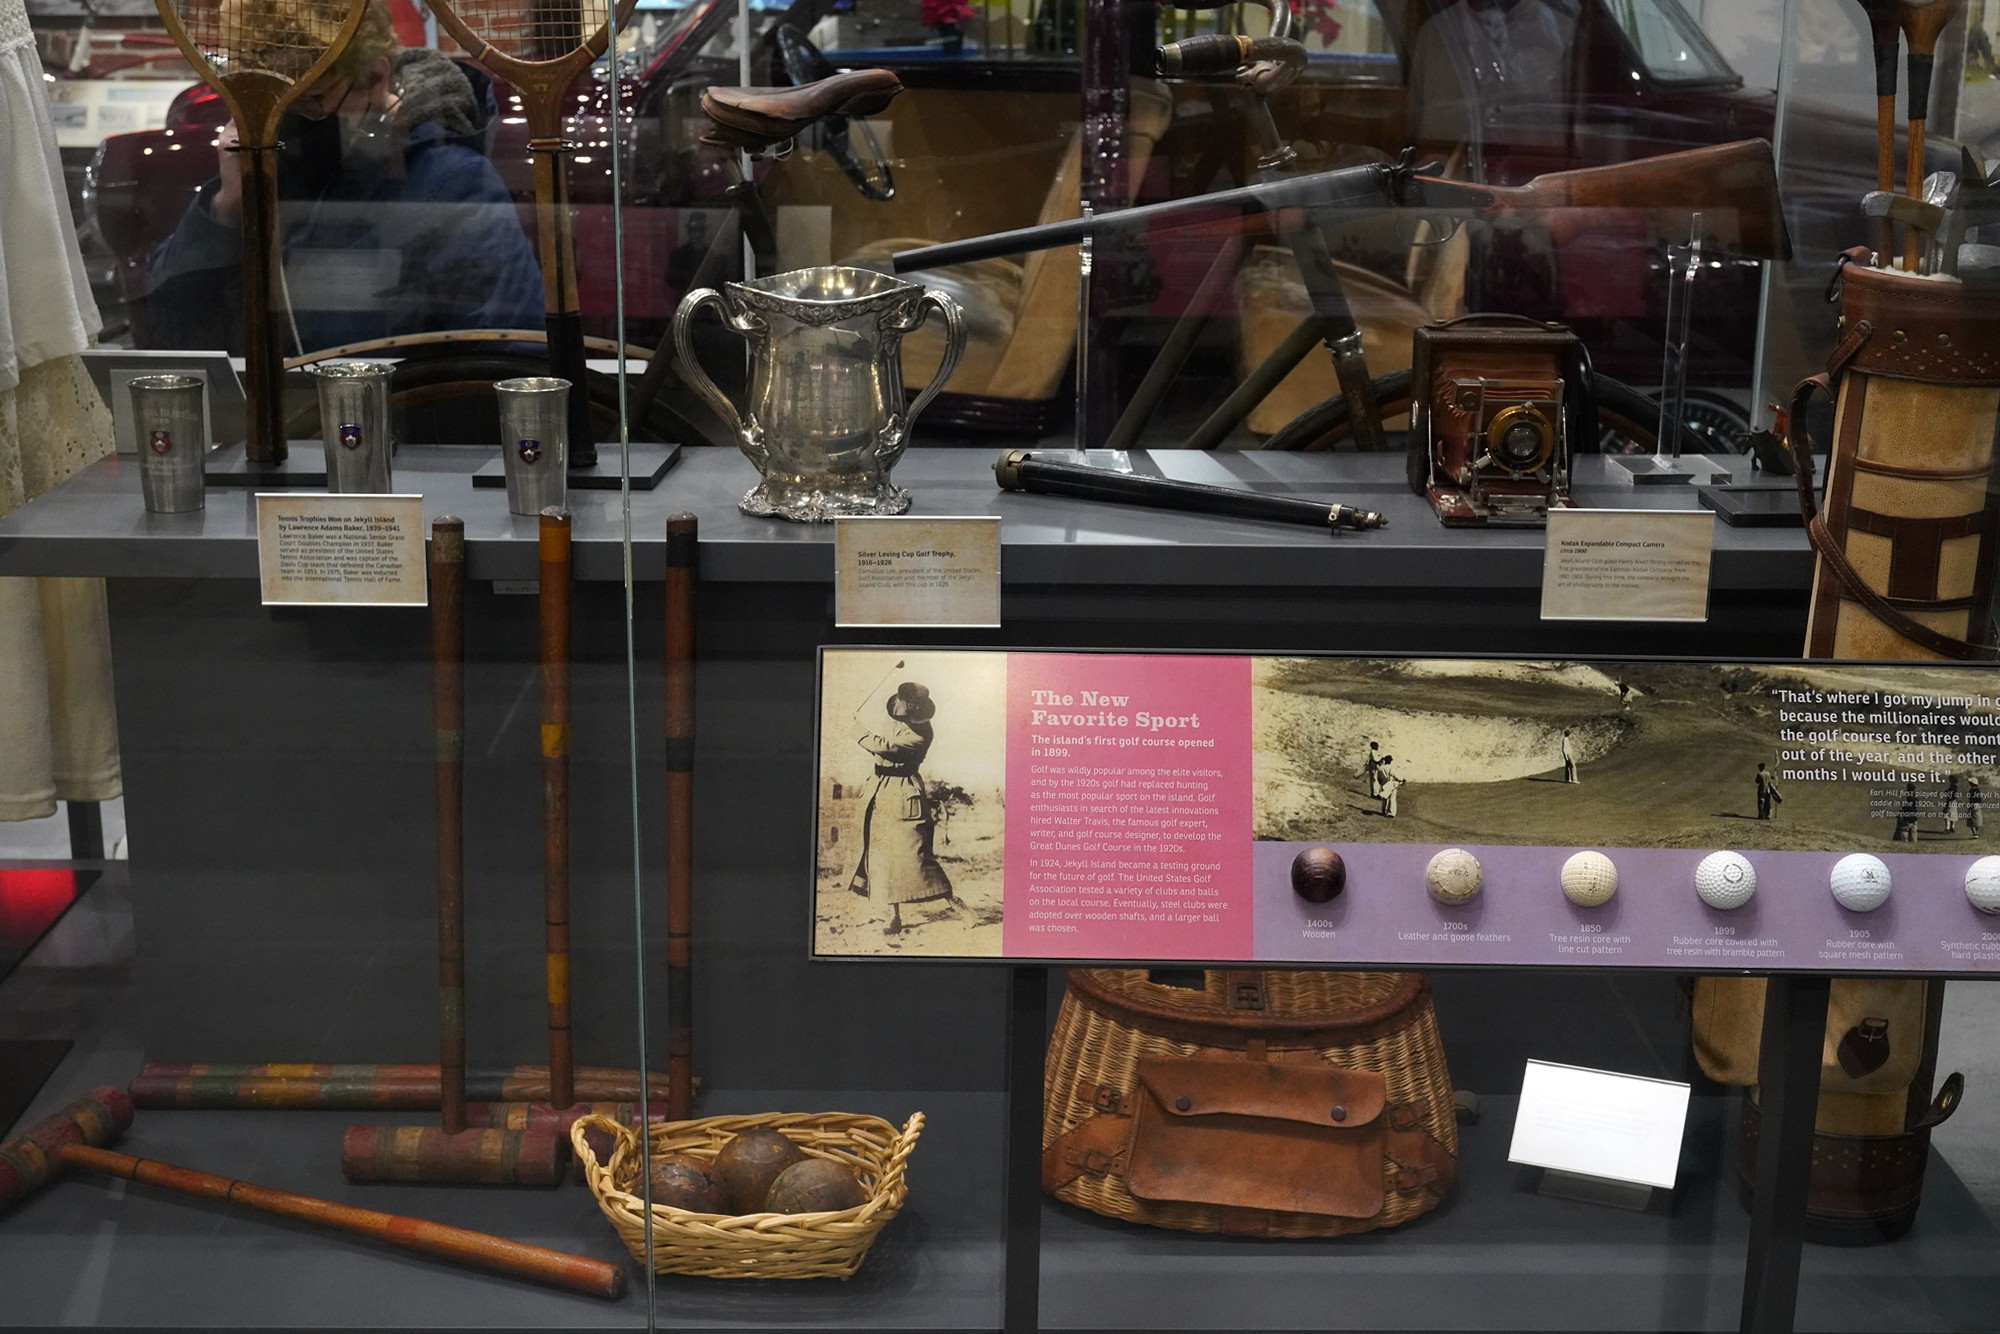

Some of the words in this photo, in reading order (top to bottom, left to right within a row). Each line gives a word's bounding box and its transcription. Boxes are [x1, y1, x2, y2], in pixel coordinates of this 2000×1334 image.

[299, 515, 326, 524] Trophies
[353, 516, 373, 524] Jekyll
[279, 524, 287, 532] by
[1580, 540, 1614, 548] Expandable
[1615, 541, 1641, 549] Compact
[878, 551, 900, 559] Loving
[901, 551, 914, 559] Cup
[1031, 690, 1073, 707] The
[1080, 690, 1130, 707] New
[1826, 691, 1869, 704] where
[1874, 692, 1878, 705] I
[1883, 692, 1906, 708] got
[1911, 695, 1932, 709] my
[1937, 696, 1972, 709] jump
[1977, 694, 1990, 707] in
[1031, 710, 1128, 727] Favorite
[1135, 711, 1200, 731] Sport
[1780, 709, 1837, 723] because
[1841, 711, 1864, 724] the
[1869, 711, 1955, 726] millionaires
[1031, 735, 1050, 745] The
[1052, 735, 1091, 745] island's
[1093, 736, 1116, 746] first
[1118, 736, 1139, 748] golf
[1141, 739, 1175, 747] course
[1177, 737, 1215, 750] opened
[1780, 729, 1803, 741] the
[1808, 729, 1837, 745] golf
[1842, 733, 1890, 743] course
[1895, 731, 1916, 744] for
[1920, 731, 1959, 745] three
[1031, 747, 1040, 757] in
[1043, 747, 1071, 757] 1899.
[1781, 748, 1805, 761] out
[1810, 749, 1825, 761] of
[1828, 749, 1852, 762] the
[1857, 752, 1892, 765] year,
[1897, 750, 1924, 763] and
[1929, 751, 1952, 764] the
[1957, 752, 1996, 764] other
[1031, 765, 1048, 774] Golf
[1067, 766, 1091, 777] wildly
[1093, 766, 1125, 778] popular
[1126, 769, 1155, 778] among
[1157, 767, 1170, 776] the
[1172, 767, 1190, 776] elite
[1192, 767, 1224, 778] visitors,
[1782, 768, 1837, 781] months
[1842, 769, 1846, 781] I
[1851, 769, 1895, 782] would
[1900, 773, 1925, 782] use
[1031, 778, 1046, 787] and
[1048, 778, 1058, 789] by
[1060, 778, 1074, 787] the
[1076, 778, 1100, 787] 1920s
[1102, 779, 1118, 790] golf
[1120, 779, 1136, 788] had
[1138, 779, 1174, 791] replaced
[1176, 780, 1208, 791] hunting
[1042, 790, 1056, 800] the
[1058, 791, 1079, 800] most
[1080, 791, 1113, 802] popular
[1115, 792, 1137, 803] sport
[1152, 792, 1166, 801] the
[1167, 792, 1195, 802] island.
[1197, 793, 1215, 802] Golf
[1030, 803, 1078, 813] enthusiasts
[1079, 804, 1087, 813] in
[1089, 804, 1117, 813] search
[1119, 805, 1128, 814] of
[1129, 805, 1144, 814] the
[1145, 805, 1169, 814] latest
[1171, 805, 1219, 815] innovations
[1030, 816, 1051, 825] hired
[1053, 816, 1081, 826] Walter
[1083, 817, 1110, 827] Travis,
[1112, 817, 1126, 826] the
[1127, 817, 1158, 827] famous
[1160, 818, 1177, 829] golf
[1179, 818, 1208, 830] expert,
[1307, 920, 1333, 928] 1400s
[1443, 922, 1468, 931] 1700s
[1580, 924, 1601, 933] 1850
[1302, 930, 1336, 939] Wooden
[1714, 927, 1736, 935] 1899
[1849, 929, 1871, 938] 1905
[1398, 932, 1430, 941] Leather
[1432, 932, 1447, 941] and
[1450, 935, 1474, 943] goose
[1476, 933, 1511, 942] feathers
[1549, 934, 1567, 943] Tree
[1569, 934, 1590, 943] resin
[1612, 935, 1631, 944] with
[1673, 936, 1702, 945] Rubber
[1725, 937, 1757, 946] covered
[1759, 938, 1778, 946] with
[1558, 944, 1574, 953] line
[1576, 945, 1589, 953] cut
[1591, 945, 1622, 956] pattern
[1826, 940, 1855, 948] Rubber
[1877, 940, 1895, 949] with
[1941, 941, 1979, 952] Synthetic
[1666, 946, 1682, 955] tree
[1683, 947, 1702, 955] resin
[1703, 947, 1720, 956] with
[1722, 947, 1755, 956] bramble
[1756, 948, 1785, 959] pattern
[1819, 952, 1847, 961] square
[1848, 951, 1871, 959] mesh
[1873, 951, 1903, 962] pattern
[1951, 951, 1971, 960] hard
